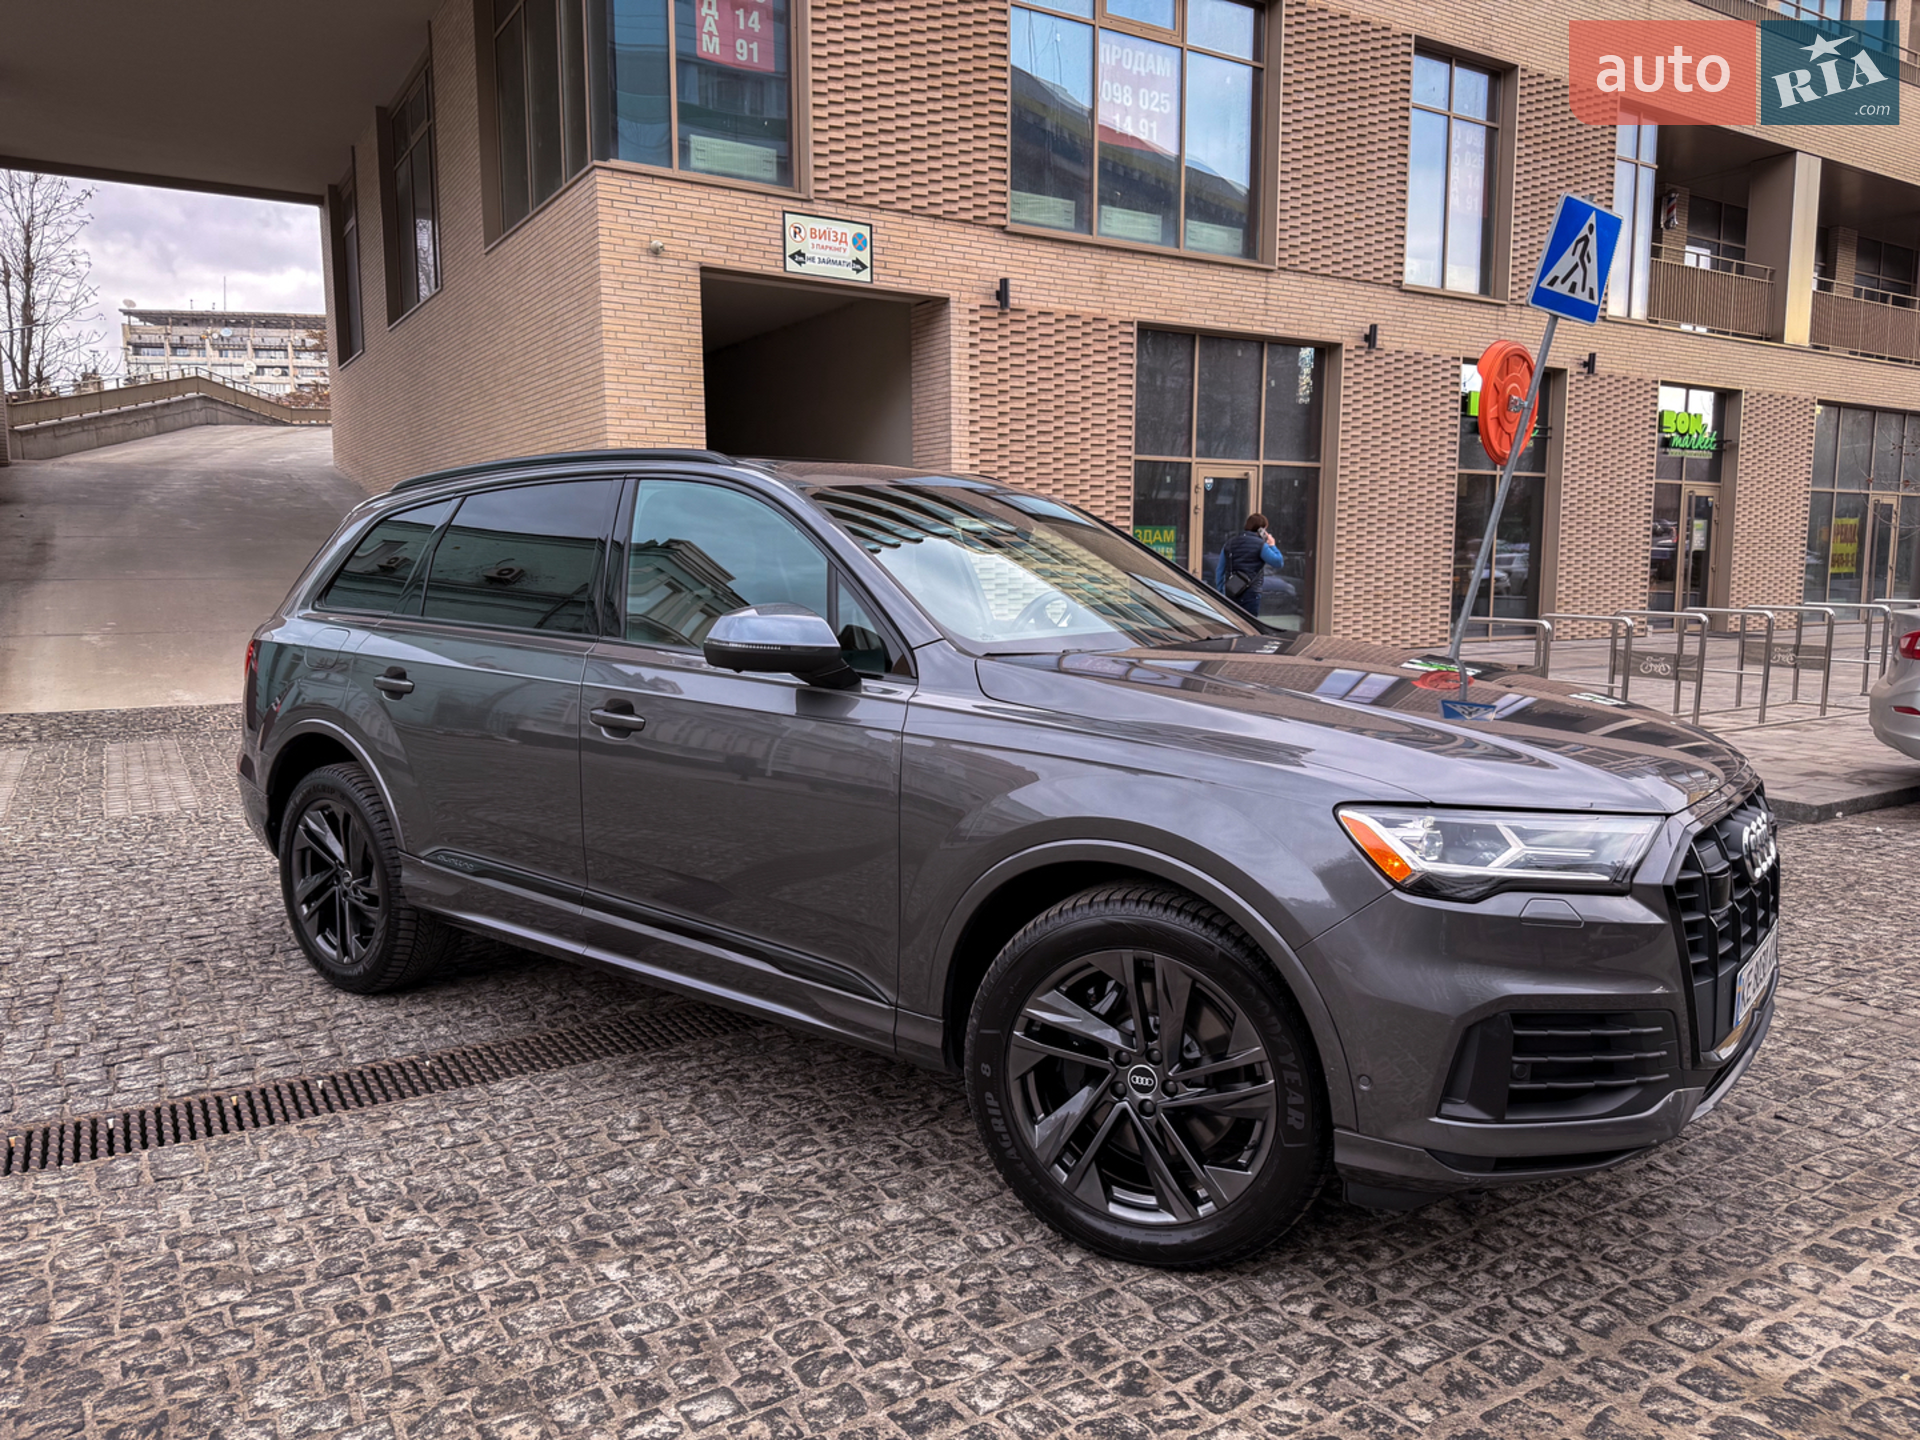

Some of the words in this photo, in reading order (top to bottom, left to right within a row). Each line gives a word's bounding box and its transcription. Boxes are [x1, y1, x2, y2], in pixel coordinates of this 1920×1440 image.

[735, 8, 761, 32] 14
[736, 38, 759, 63] 91
[1100, 43, 1172, 77] ПРОДАМ
[1101, 80, 1132, 107] 098
[1139, 88, 1171, 114] 025
[1113, 113, 1134, 138] 14
[1140, 118, 1157, 142] 91
[810, 227, 848, 246] ВИЇЗД
[816, 244, 847, 253] ПАРКІНГУ
[806, 255, 816, 264] НЕ
[817, 256, 852, 269] ЗАЙМАТИ
[1671, 424, 1718, 450] market
[980, 1062, 992, 1078] 8
